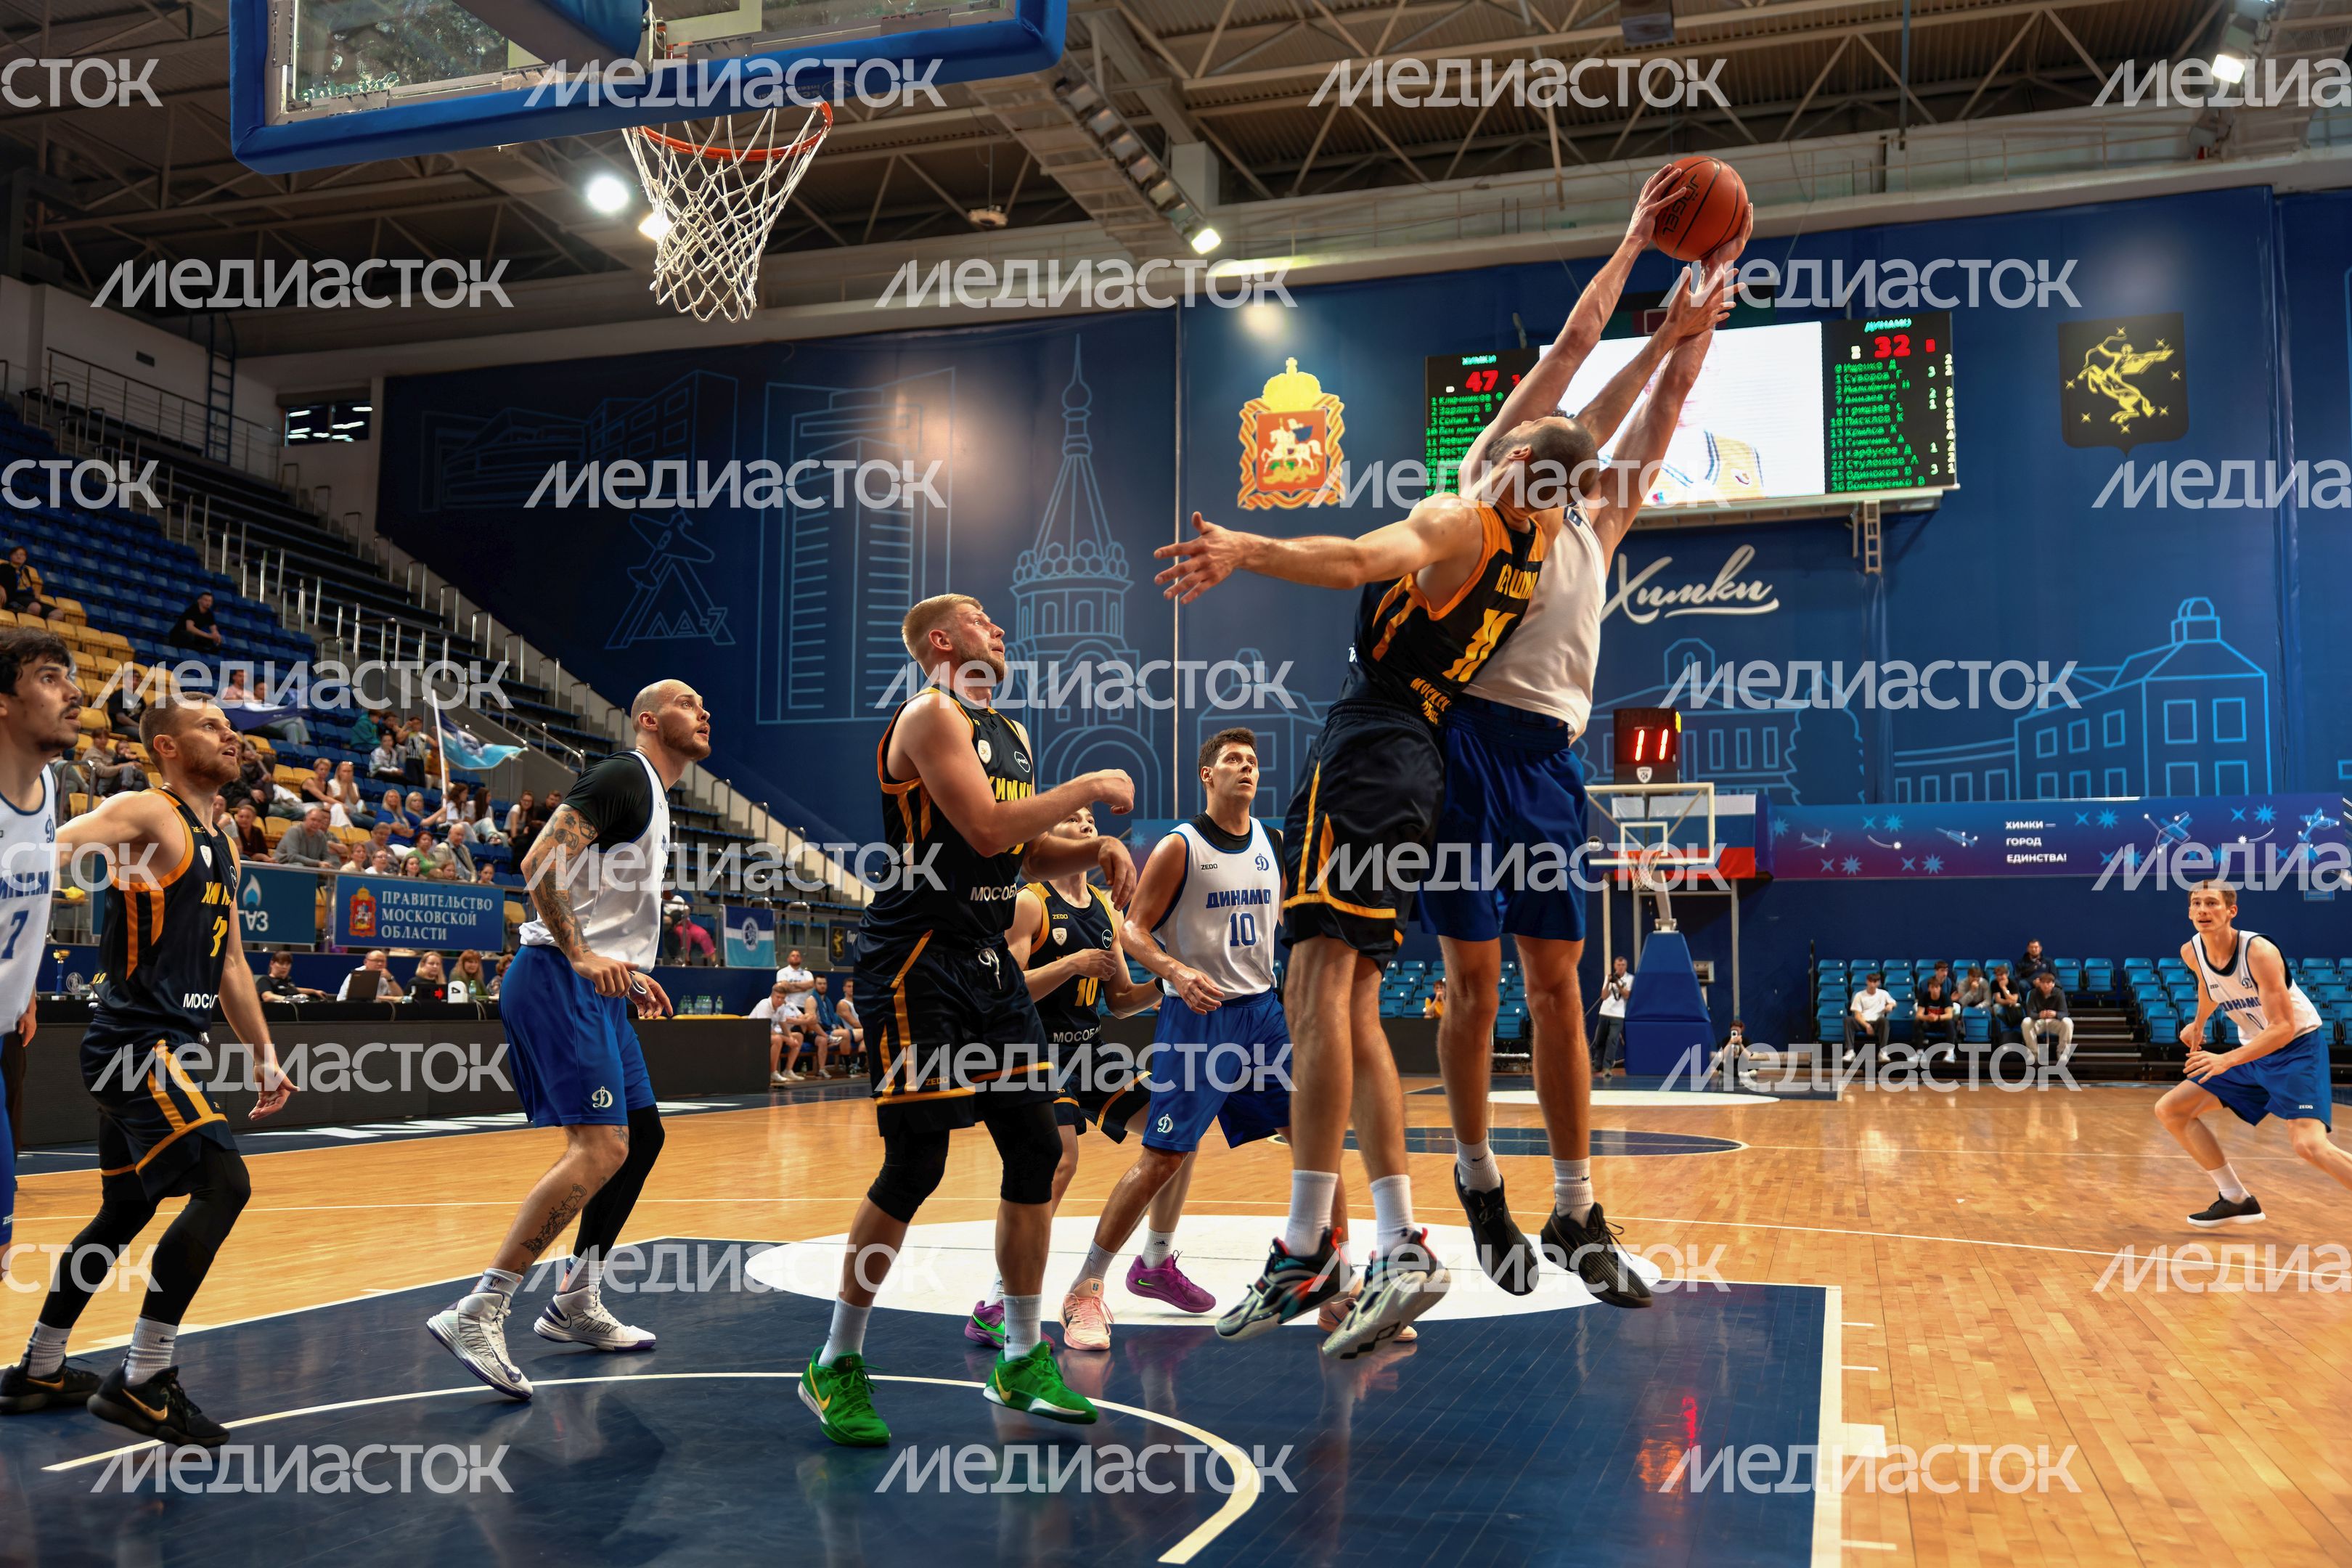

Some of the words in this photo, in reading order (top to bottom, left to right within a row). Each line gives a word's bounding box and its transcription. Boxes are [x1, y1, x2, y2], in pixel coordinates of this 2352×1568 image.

[1874, 334, 1911, 358] 32
[1466, 369, 1498, 392] 47
[1635, 729, 1669, 761] 11
[2005, 820, 2043, 830] ХИМКИ
[2006, 837, 2042, 847] ГОРОД
[2006, 853, 2067, 864] ЕДИНСТВА!
[382, 891, 494, 911] ПРАВИТЕЛЬСТВО
[1206, 889, 1271, 909] ДИНАМО
[381, 908, 477, 926] МОСКОВСКОЙ
[1, 910, 29, 960] 7
[381, 925, 447, 940] ОБЛАСТИ
[1230, 912, 1257, 947] 10
[1074, 977, 1098, 1007] 10
